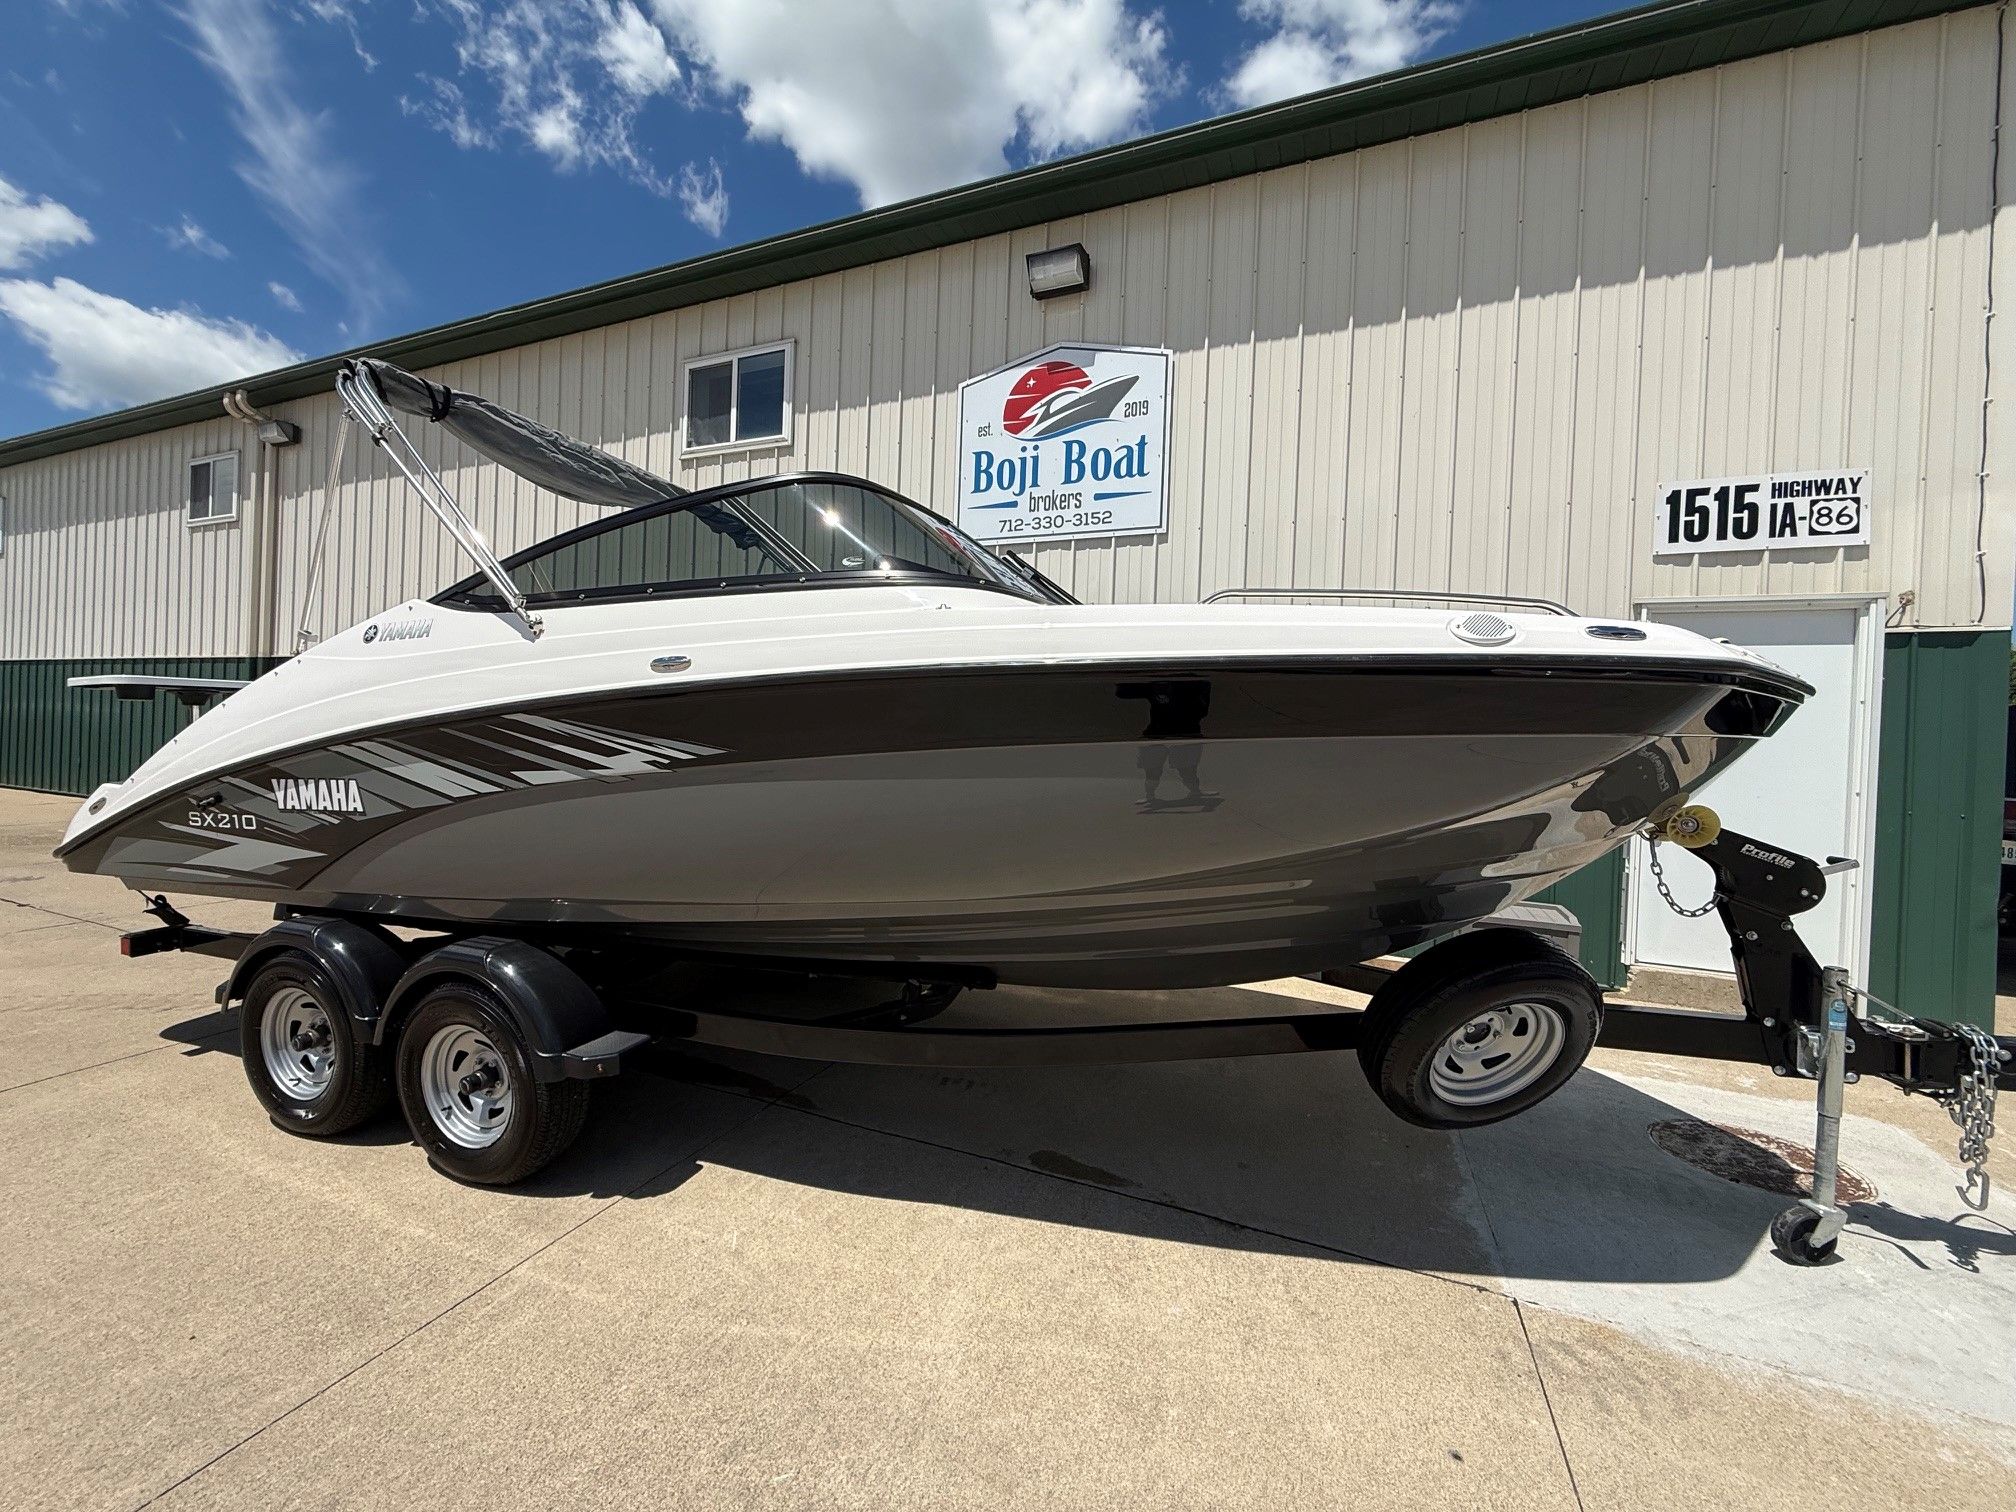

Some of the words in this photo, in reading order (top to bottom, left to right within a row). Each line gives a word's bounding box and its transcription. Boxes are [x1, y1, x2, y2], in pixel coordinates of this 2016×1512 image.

[977, 423, 993, 437] est.
[1124, 400, 1149, 418] 2019
[970, 444, 1041, 497] Boji
[1061, 434, 1150, 485] Boat
[1770, 476, 1863, 499] HIGHWAY
[1028, 490, 1082, 513] brokers
[1665, 483, 1760, 544] 1515
[998, 510, 1113, 533] 712-330-3152
[1814, 505, 1854, 527] 86
[378, 618, 434, 642] YAMAHA
[271, 778, 365, 813] YAMAHA
[188, 811, 257, 829] SX210
[1740, 843, 1796, 869] Profile
